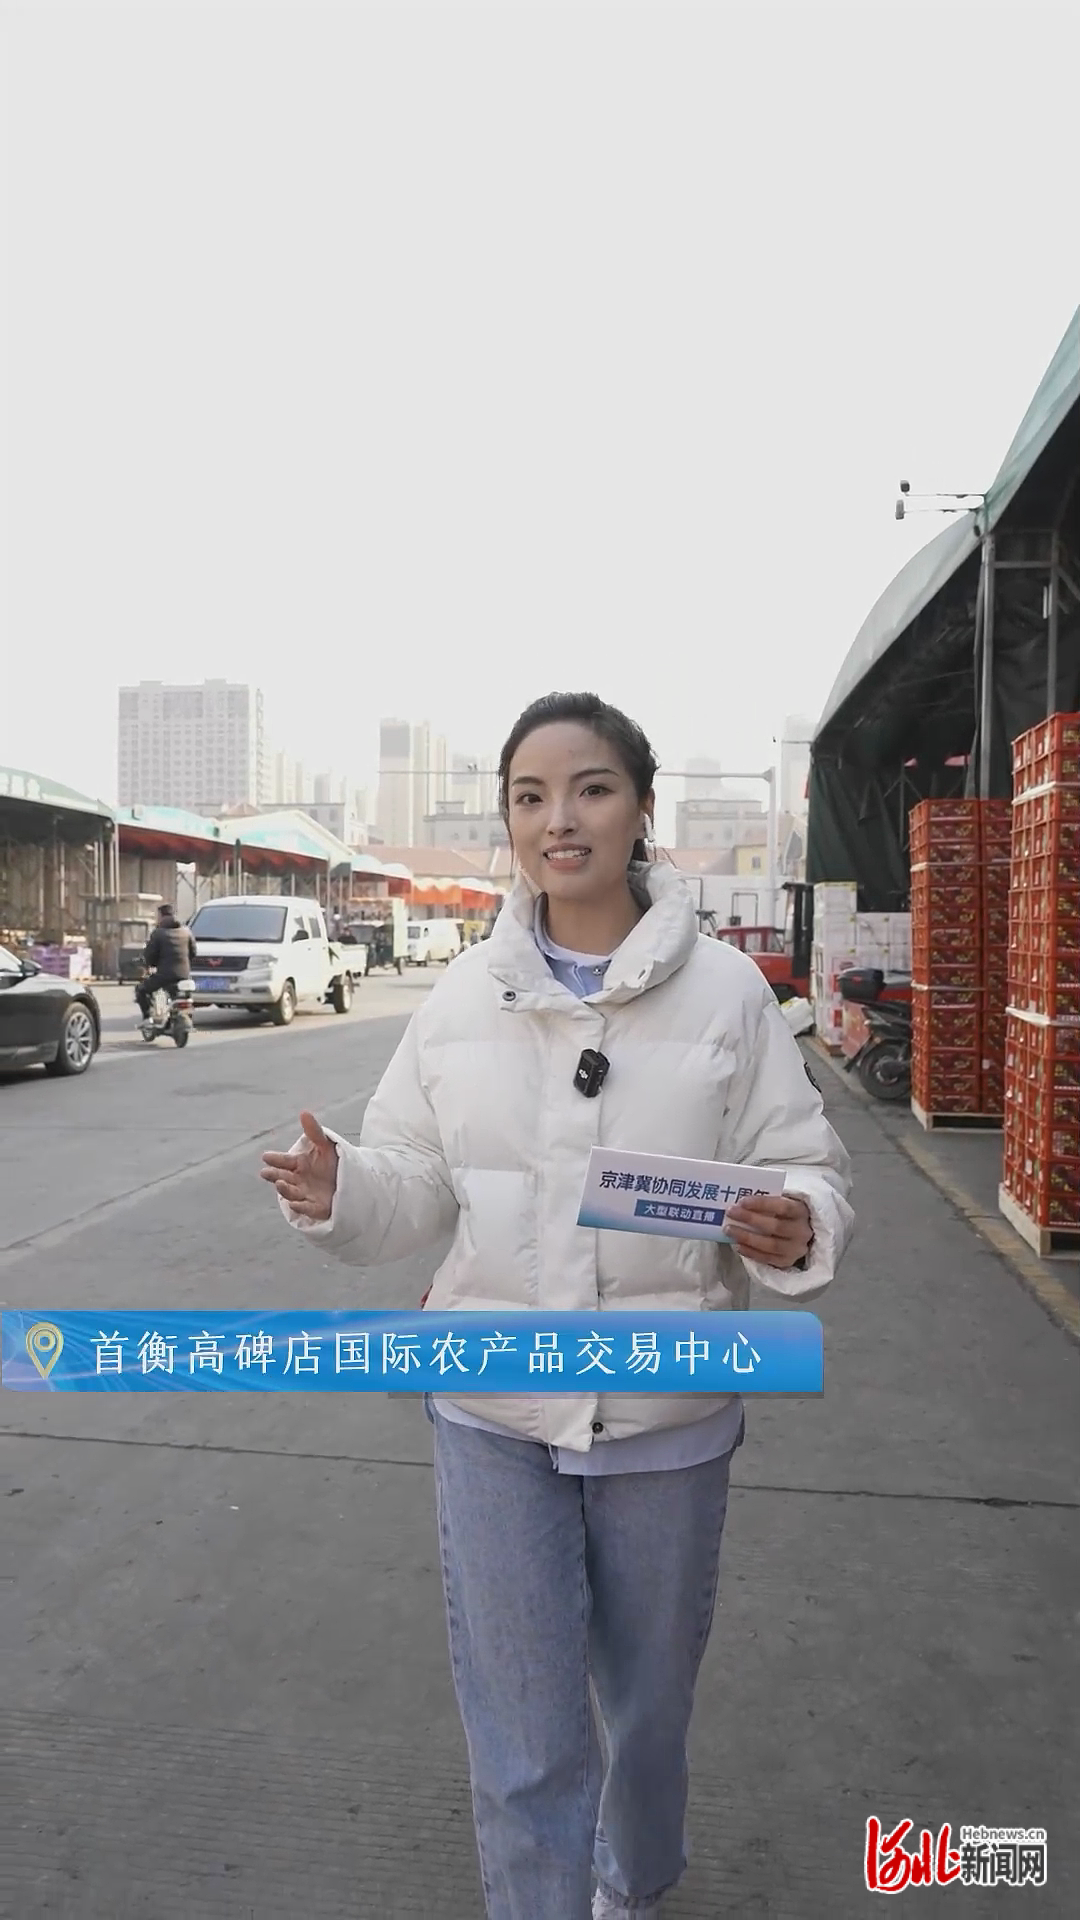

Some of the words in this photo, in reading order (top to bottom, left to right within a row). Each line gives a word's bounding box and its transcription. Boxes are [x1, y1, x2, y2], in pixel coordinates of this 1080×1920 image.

[643, 1204, 716, 1222] 大型联动直播
